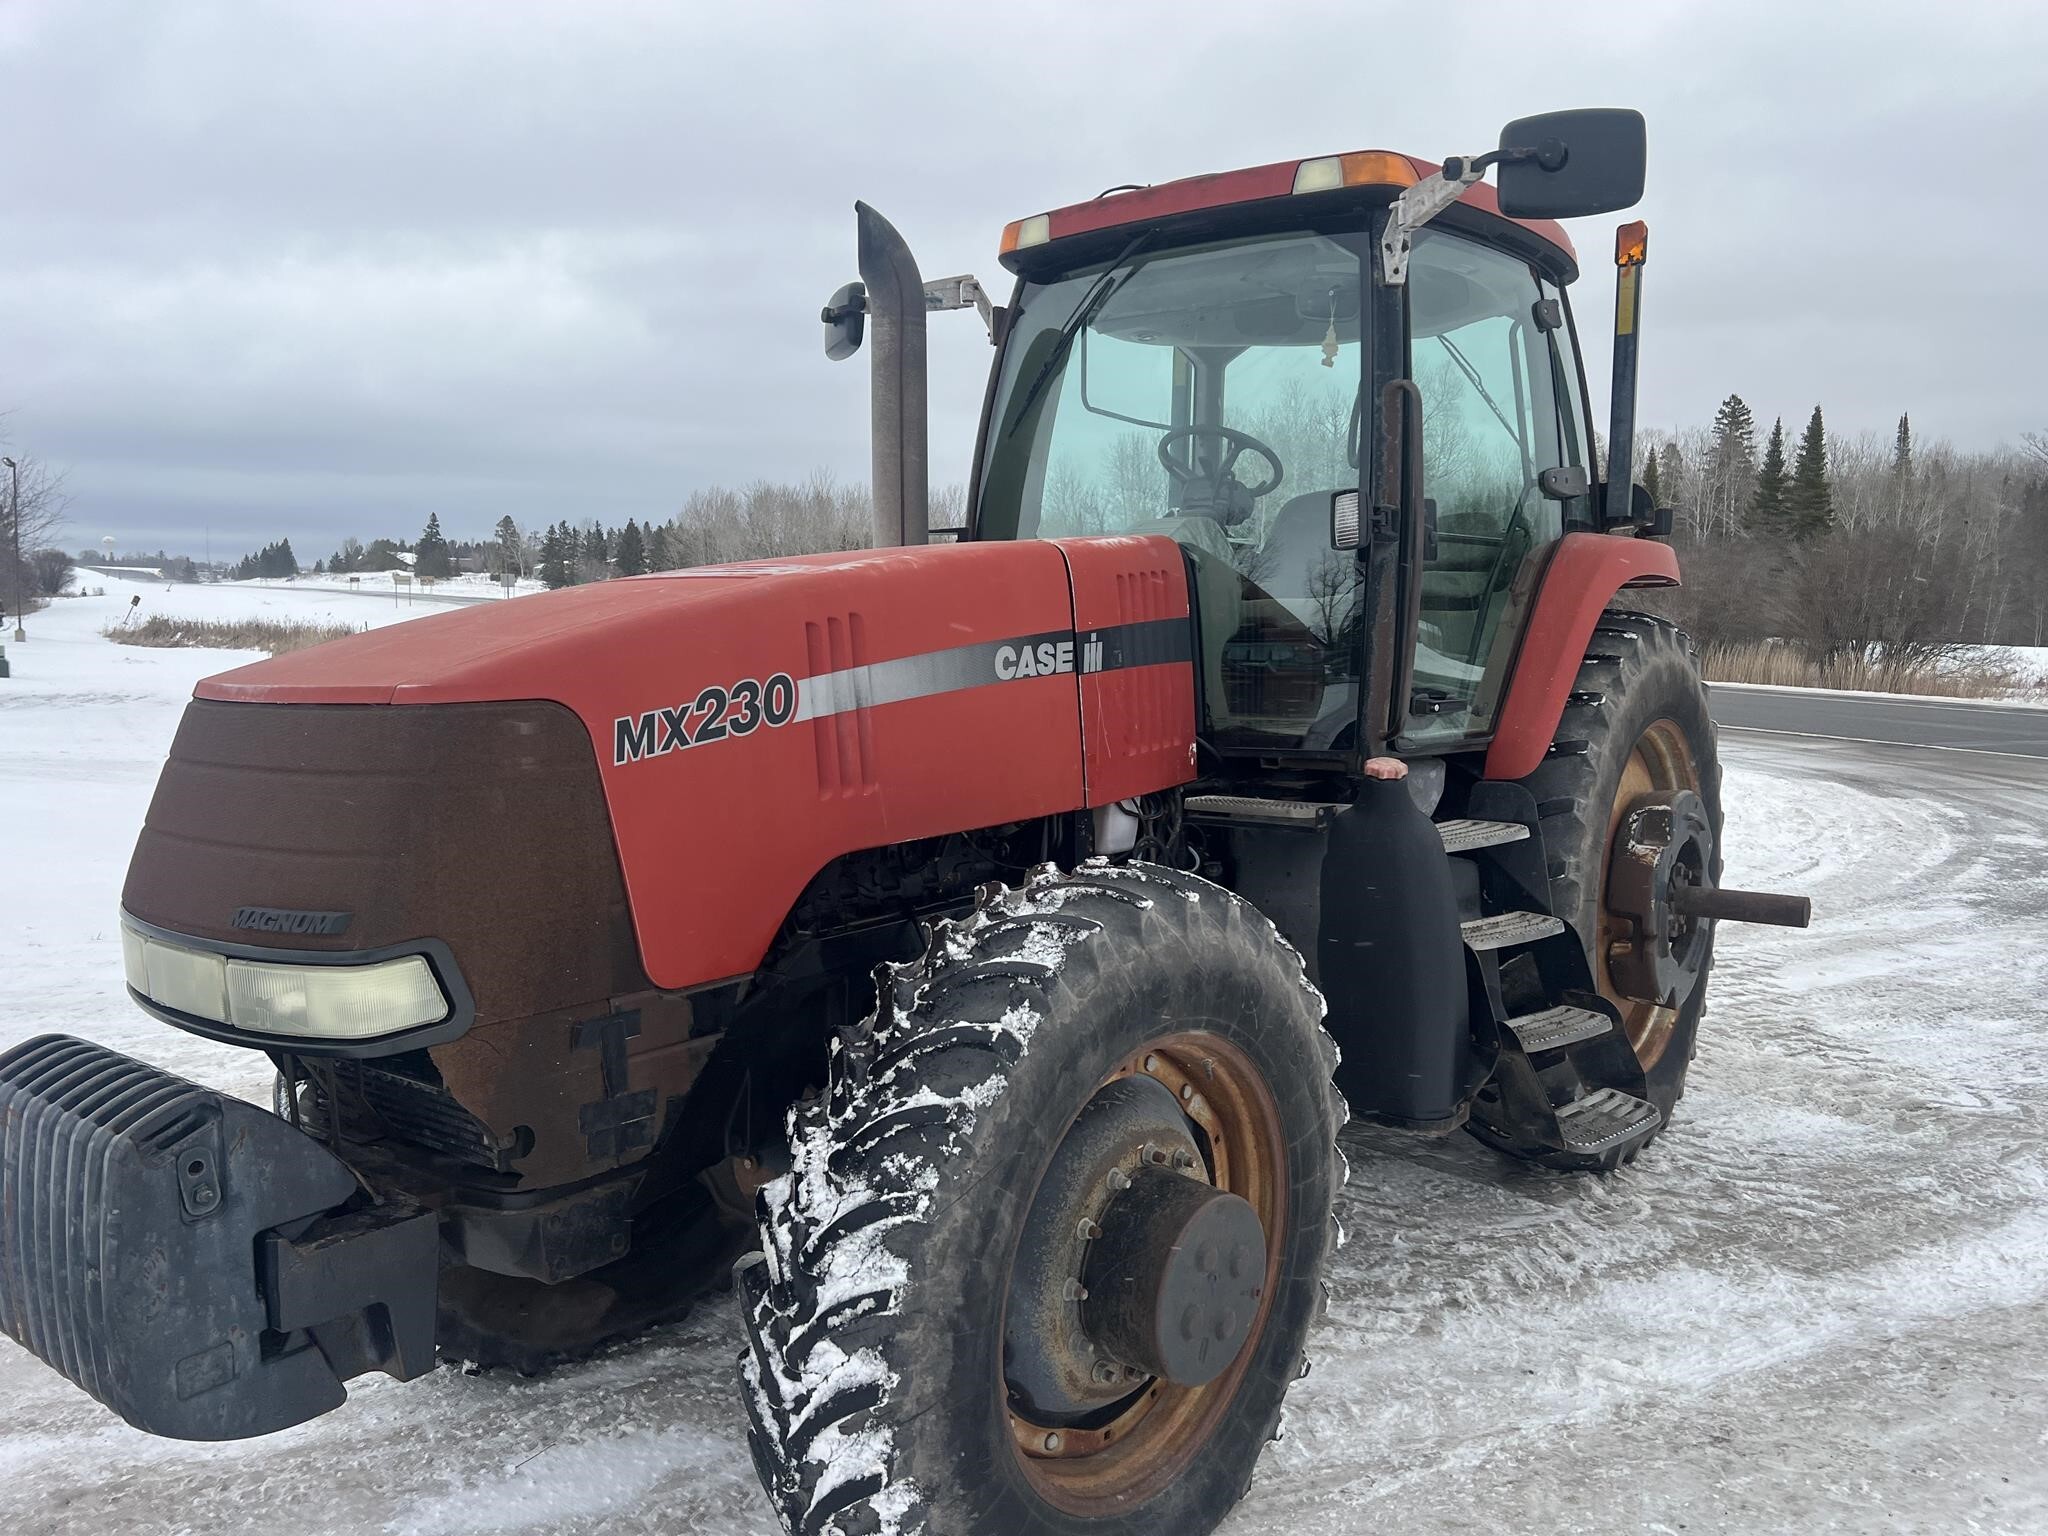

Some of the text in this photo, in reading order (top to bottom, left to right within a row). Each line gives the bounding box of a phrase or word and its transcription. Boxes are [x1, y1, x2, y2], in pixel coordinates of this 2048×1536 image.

[995, 642, 1073, 680] CASE
[614, 672, 795, 767] MX230
[232, 908, 335, 935] MAGNUM
